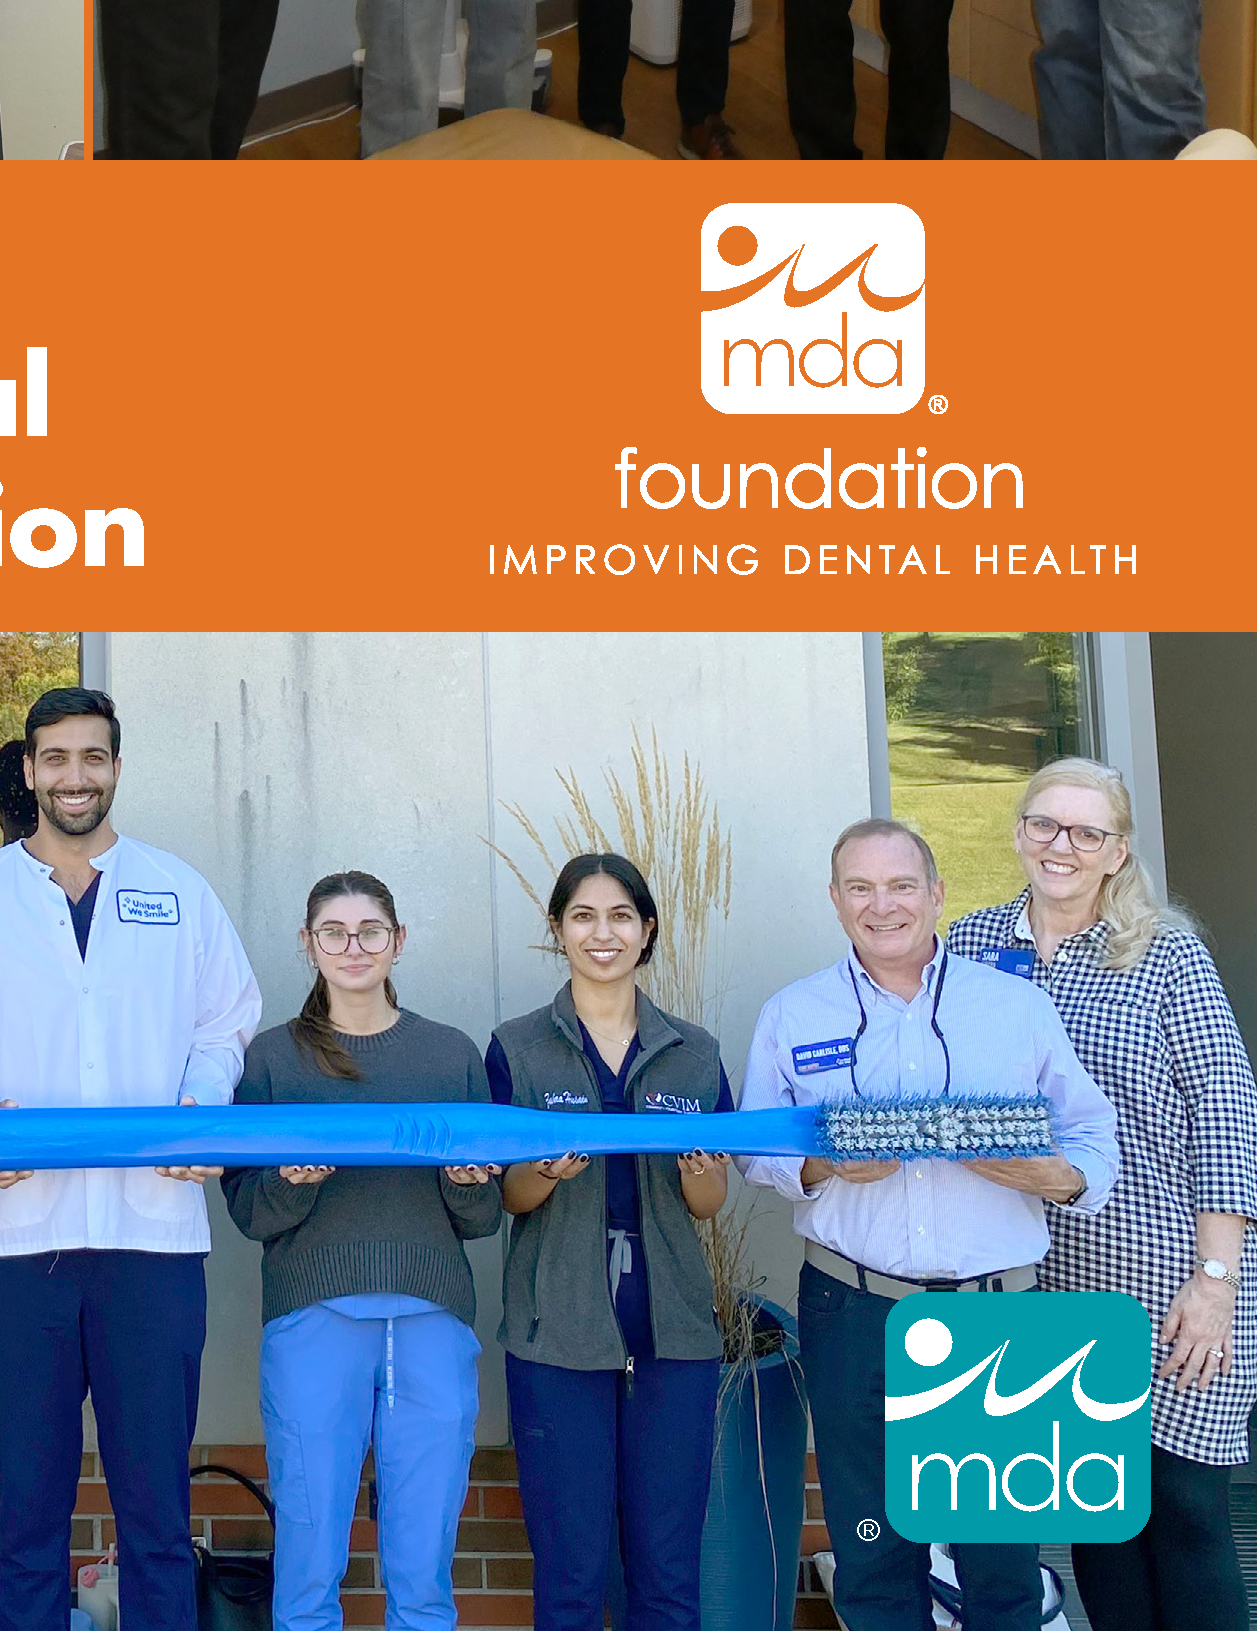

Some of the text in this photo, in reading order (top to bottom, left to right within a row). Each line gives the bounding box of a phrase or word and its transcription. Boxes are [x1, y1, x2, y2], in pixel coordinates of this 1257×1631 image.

[133, 900, 162, 909] United
[128, 907, 142, 916] We
[663, 1095, 701, 1111] CVIM
